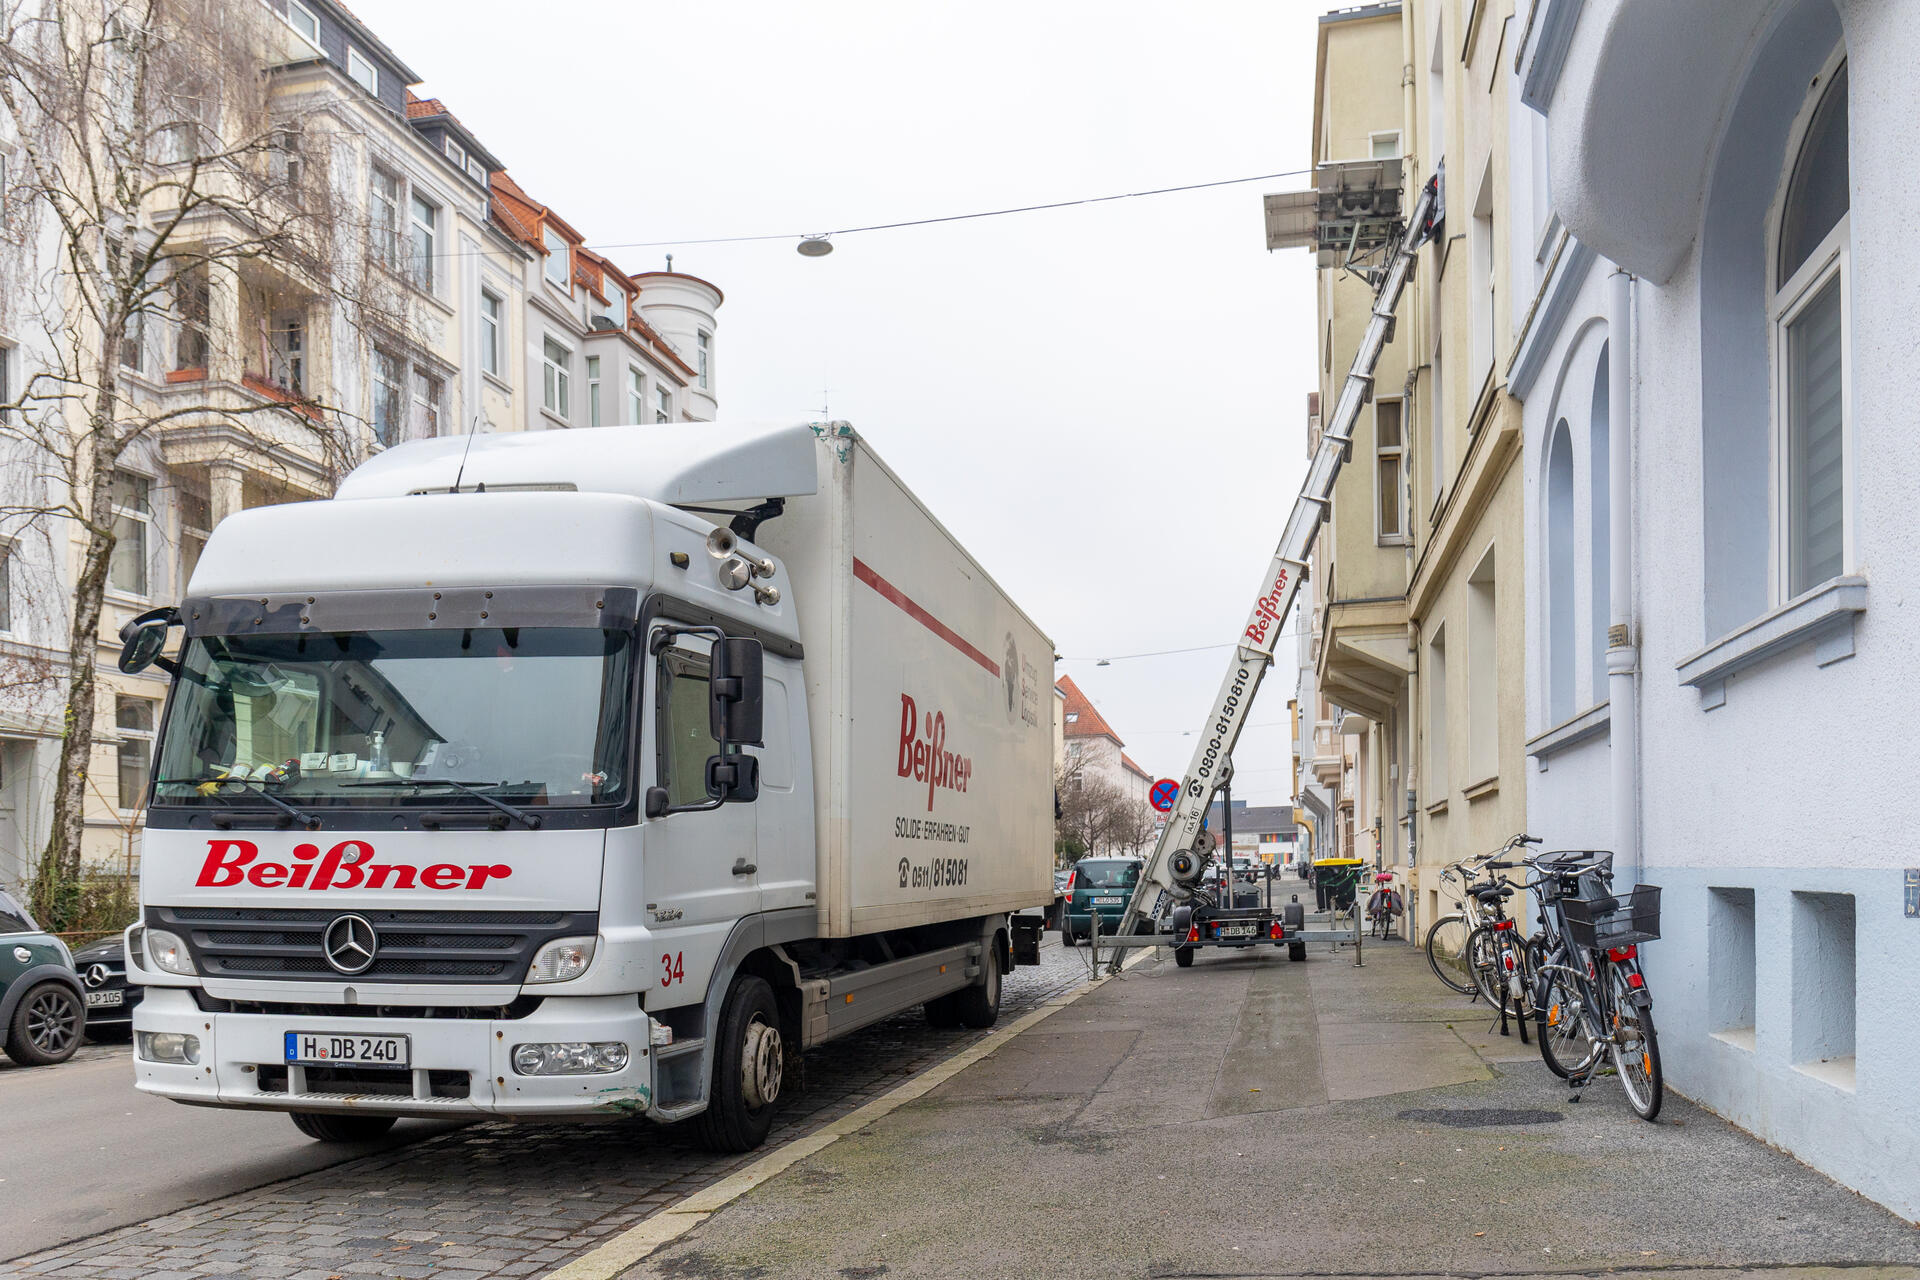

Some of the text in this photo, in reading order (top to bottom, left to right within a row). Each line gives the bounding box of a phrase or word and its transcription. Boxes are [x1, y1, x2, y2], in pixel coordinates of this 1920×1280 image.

[1245, 568, 1288, 645] Beißner
[1198, 668, 1249, 779] 0800-8150810
[897, 692, 972, 812] Beißner
[194, 839, 513, 891] Beißner
[911, 857, 968, 891] 0511/815081
[661, 951, 685, 987] 34
[88, 991, 121, 1005] LP 105
[304, 1036, 317, 1058] H
[330, 1038, 355, 1059] DB
[360, 1039, 397, 1061] 240
